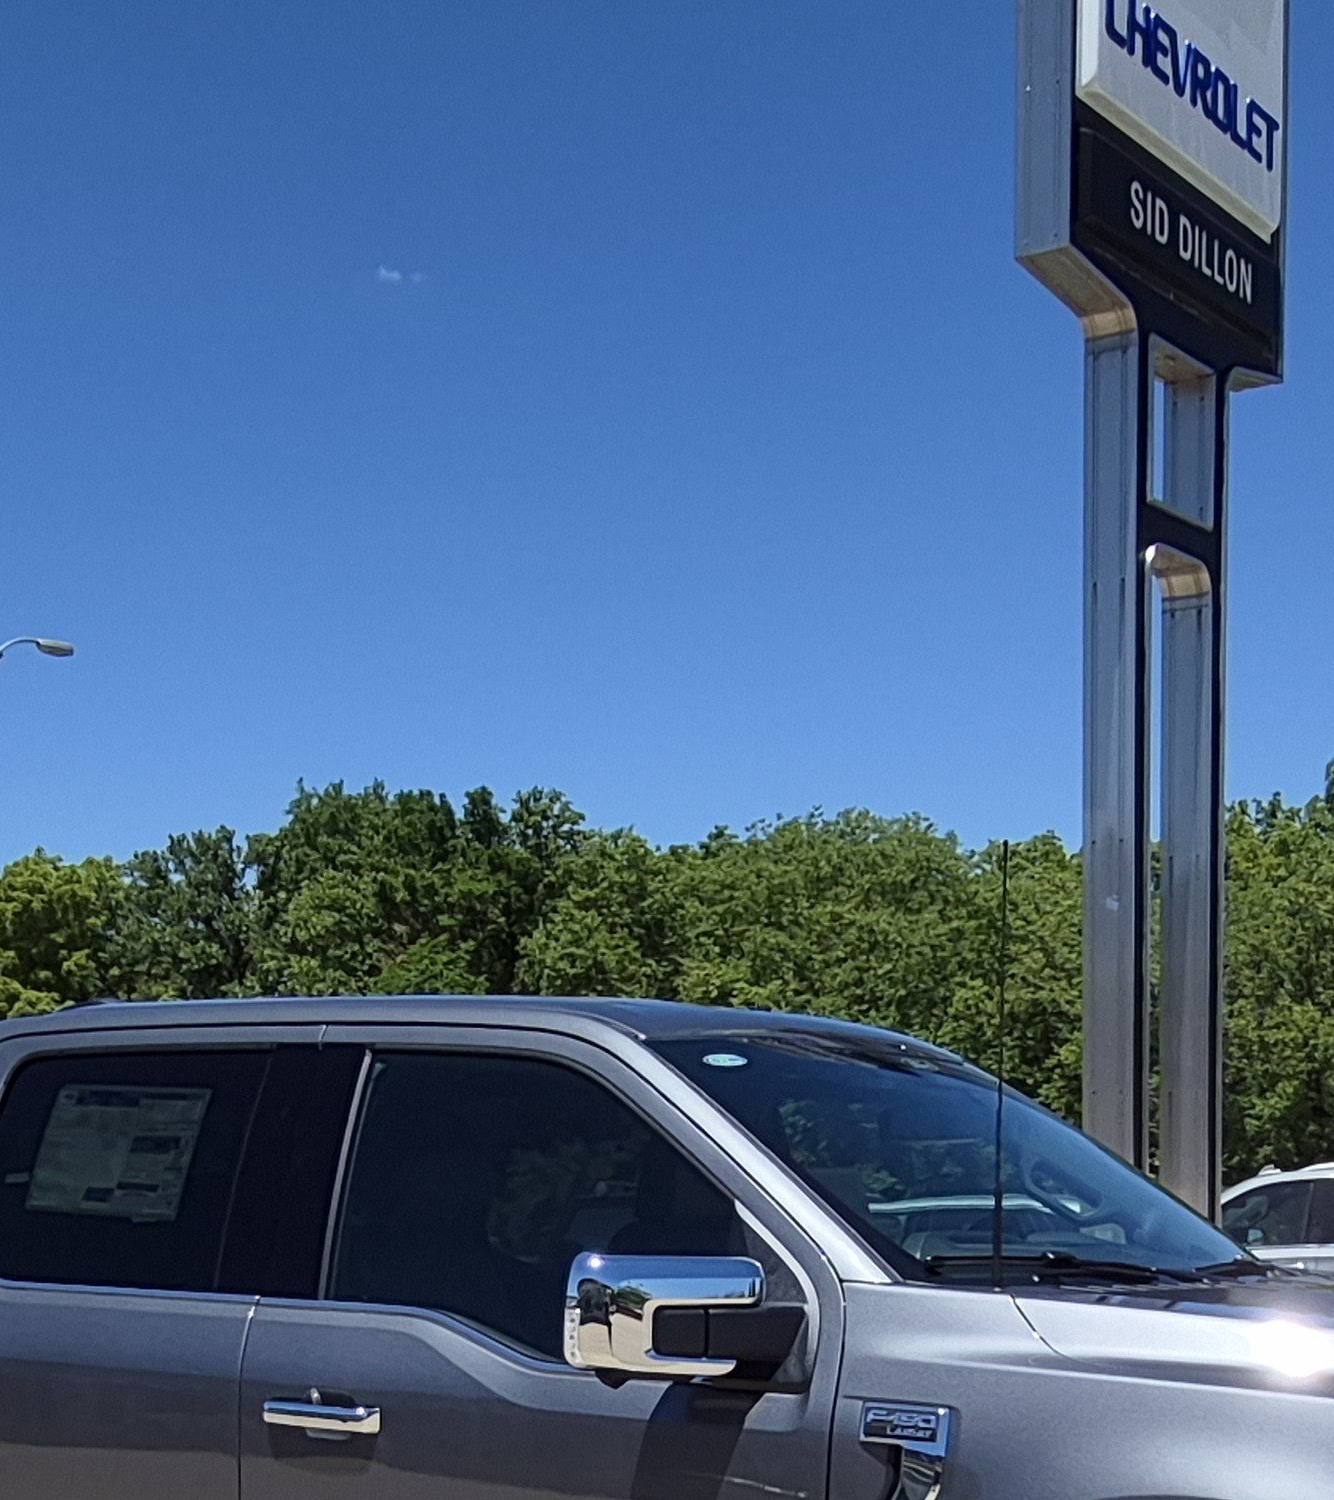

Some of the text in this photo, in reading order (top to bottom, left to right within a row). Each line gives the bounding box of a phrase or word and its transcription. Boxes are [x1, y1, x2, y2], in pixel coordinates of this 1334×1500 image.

[1105, 0, 1280, 172] CHEVROLET
[1130, 180, 1252, 305] SID DILLON
[867, 1409, 937, 1428] F-150
